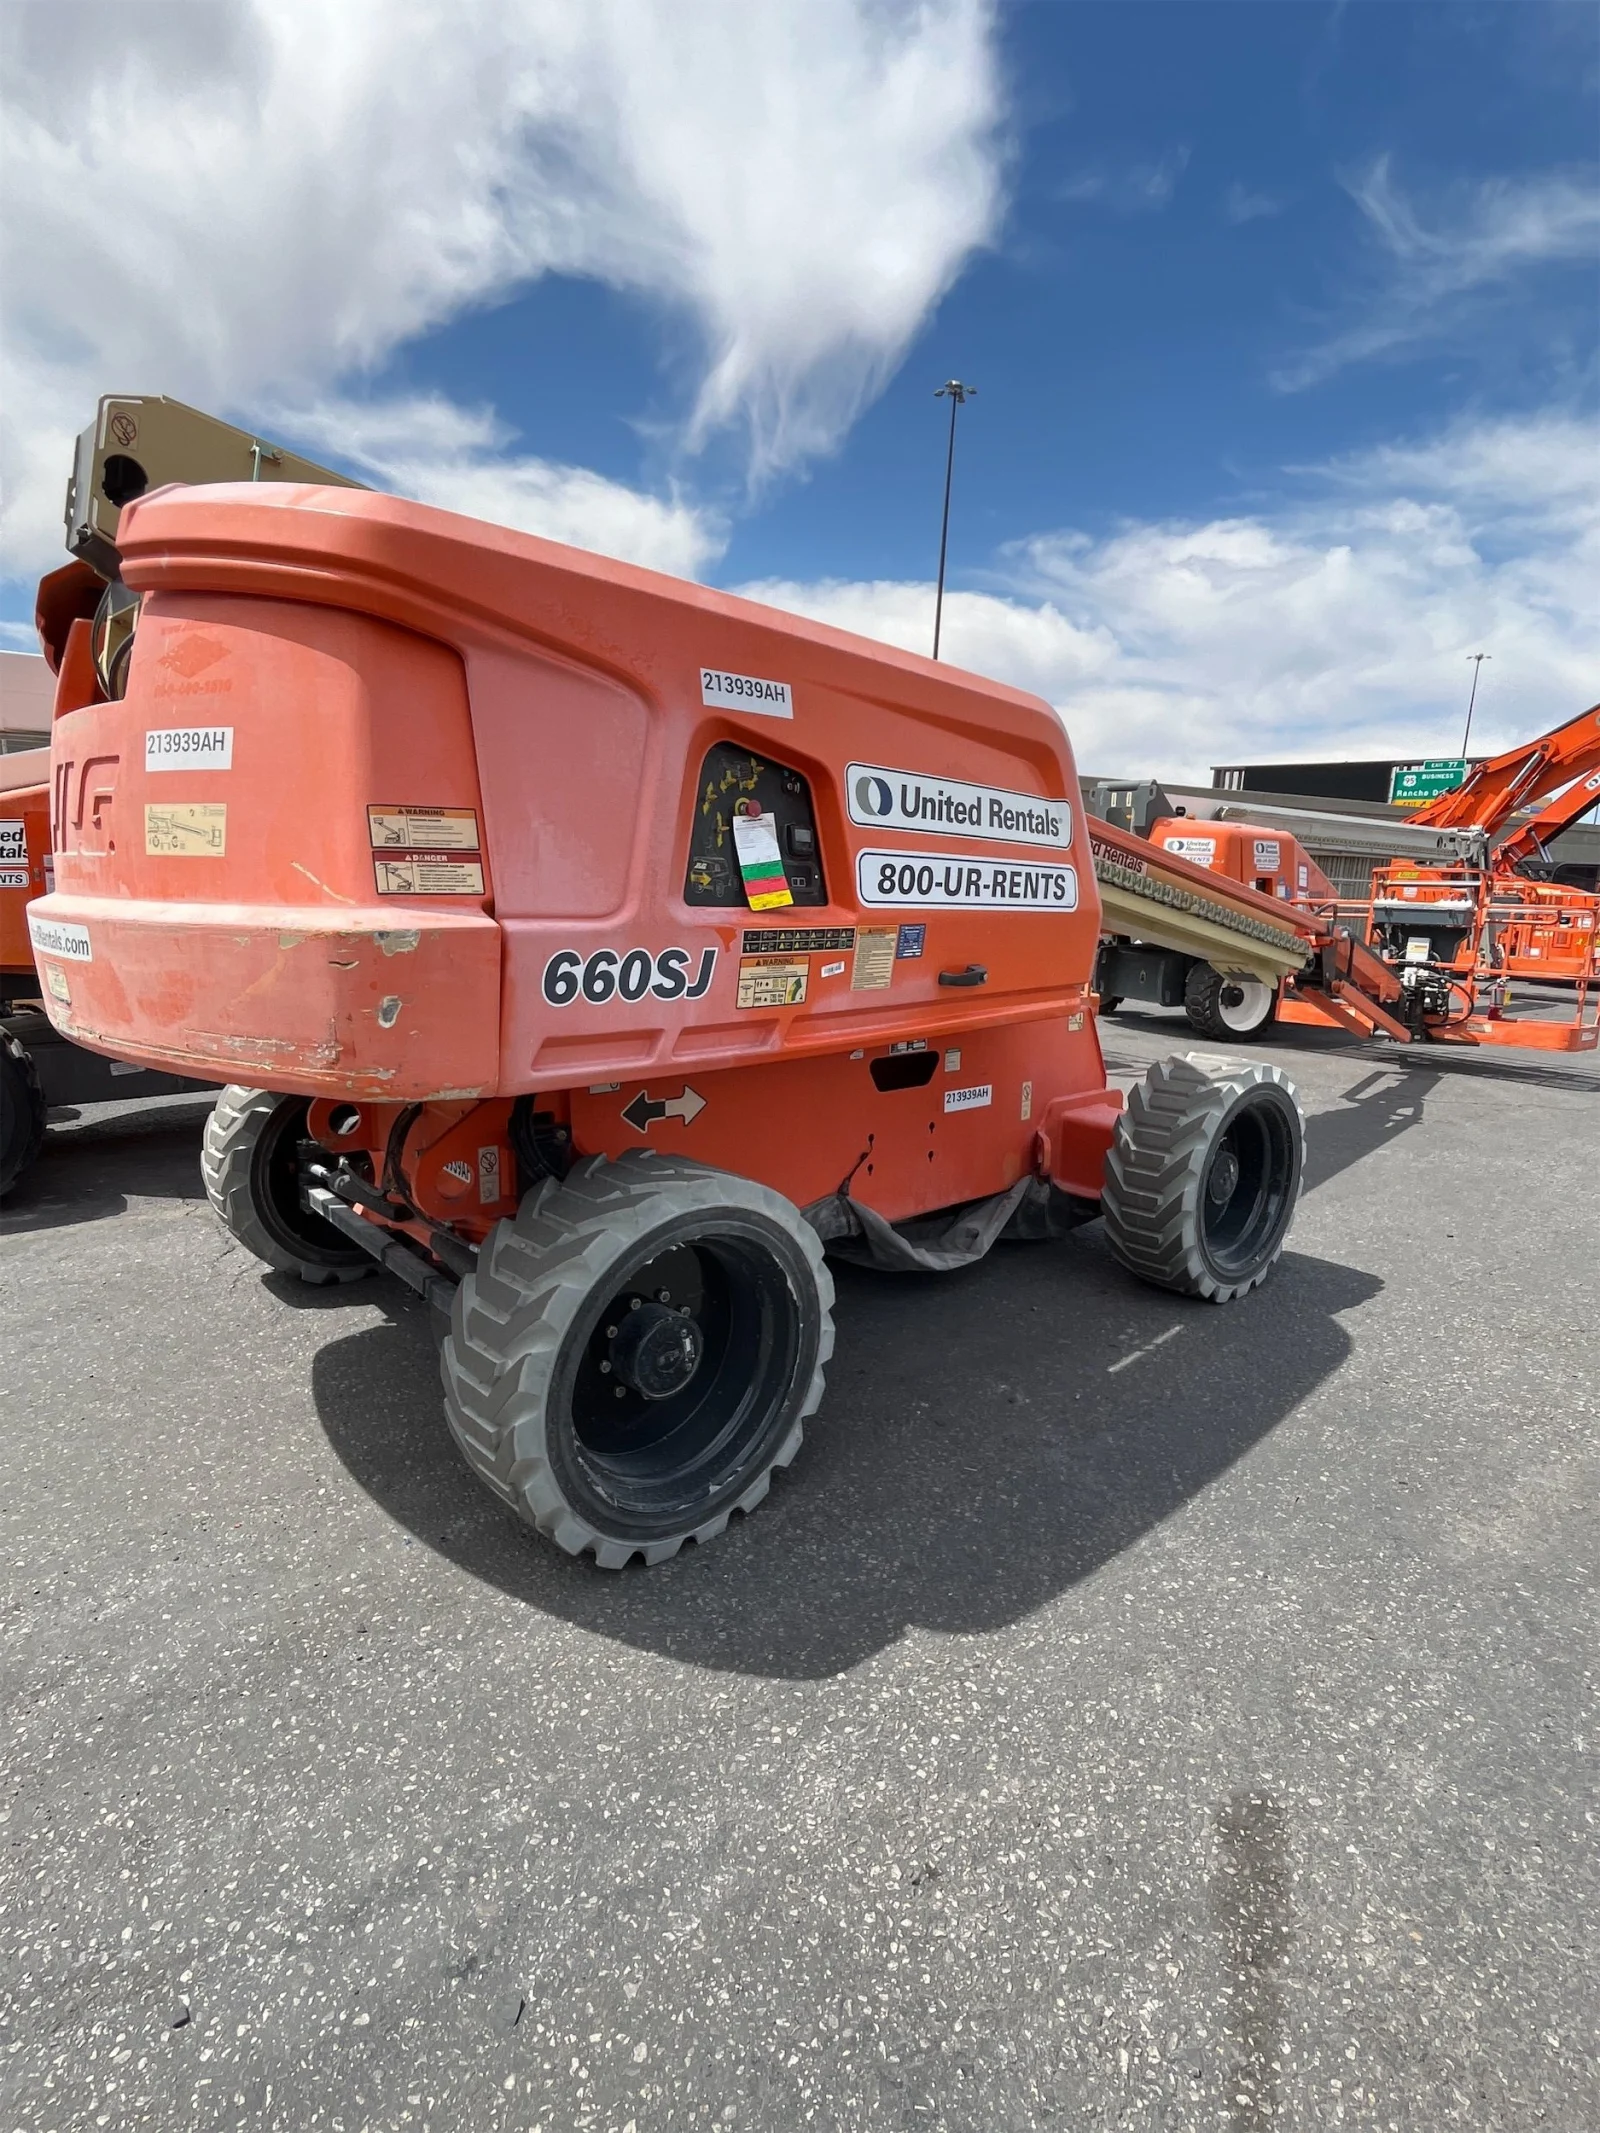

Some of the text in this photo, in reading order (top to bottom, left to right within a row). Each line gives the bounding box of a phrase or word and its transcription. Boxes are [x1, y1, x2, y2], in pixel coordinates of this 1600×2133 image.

[703, 672, 785, 703] 213939AH
[147, 731, 226, 755] 213939AH
[1396, 789, 1429, 797] Rancho
[406, 808, 446, 817] WARNING
[901, 784, 1060, 838] United Rentals
[412, 854, 448, 862] DANGER
[1102, 844, 1143, 873] Rentals
[877, 863, 1066, 901] 800-UR-RENTS
[543, 948, 718, 1006] 660SJ
[946, 1087, 989, 1104] 213939AH
